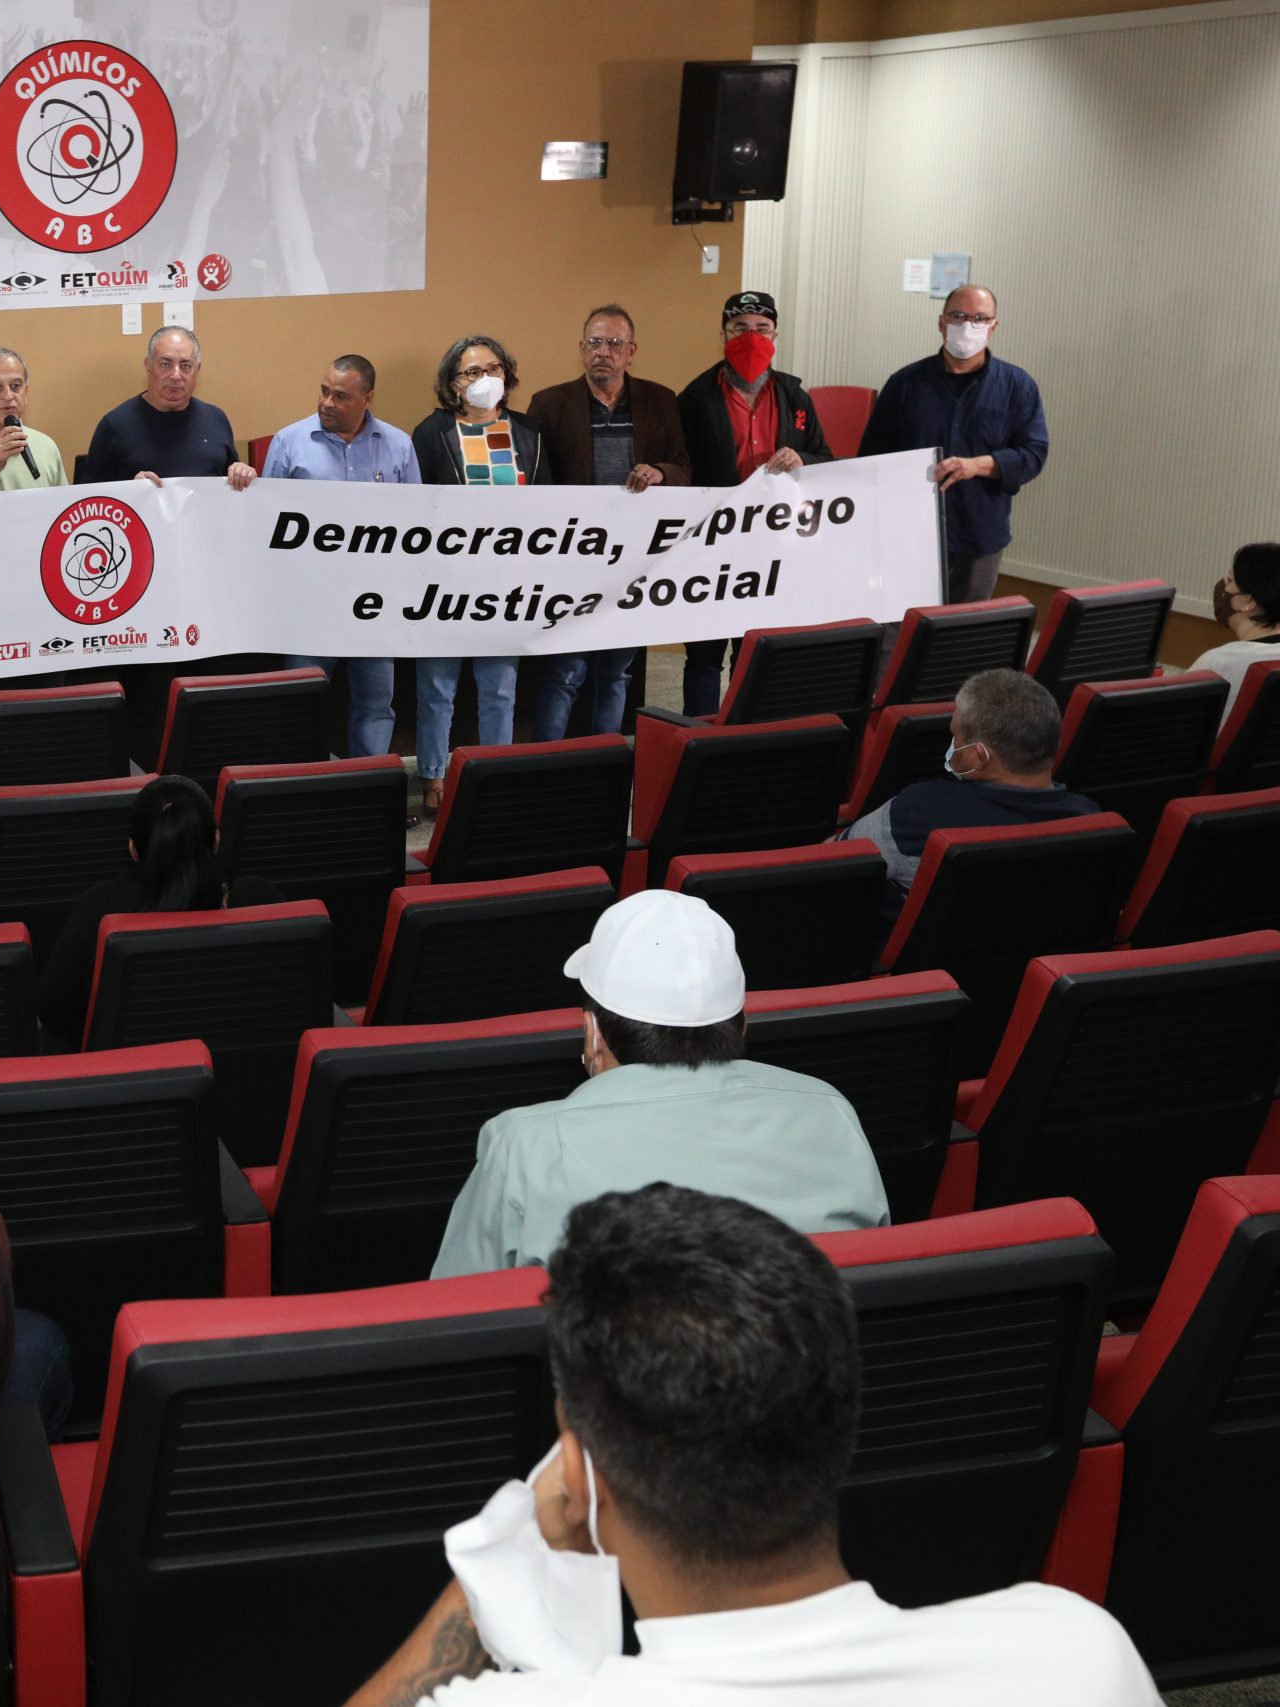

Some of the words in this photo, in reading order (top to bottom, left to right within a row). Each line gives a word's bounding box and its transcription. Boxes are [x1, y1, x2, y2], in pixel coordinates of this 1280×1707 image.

[15, 49, 142, 99] QUÍMICOS
[725, 304, 774, 318] MST
[60, 503, 131, 534] QUÍMICOS
[269, 511, 624, 565] Democracia,
[352, 592, 384, 620] e
[402, 584, 603, 629] Justiça
[617, 559, 782, 610] Social
